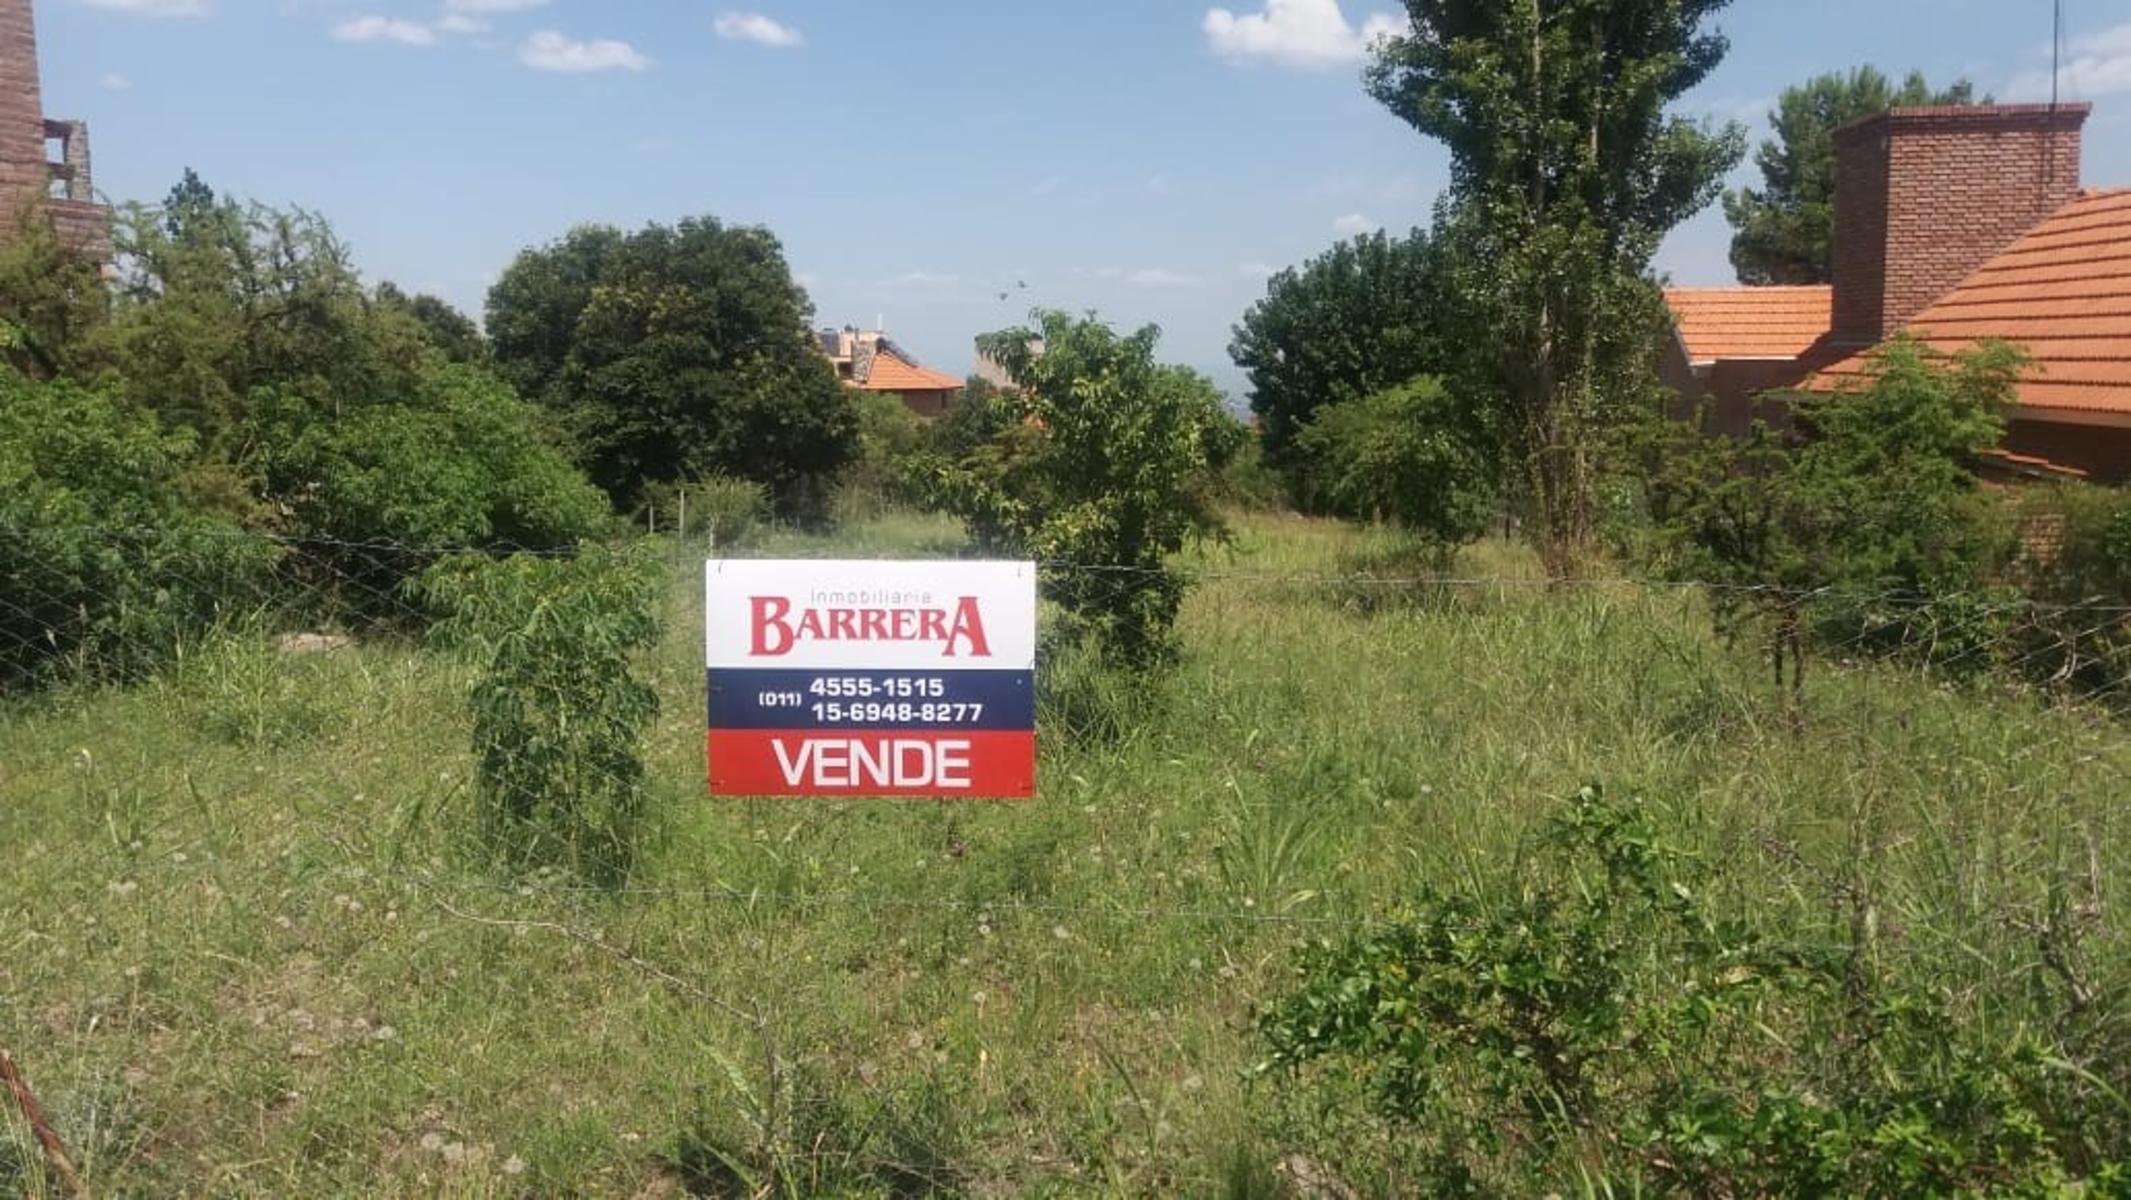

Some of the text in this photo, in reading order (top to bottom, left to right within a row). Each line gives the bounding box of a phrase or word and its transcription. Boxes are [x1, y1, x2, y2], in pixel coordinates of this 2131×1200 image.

[748, 596, 992, 656] BARRERA
[809, 678, 944, 697] 4555-1515
[758, 691, 802, 707] (011)
[811, 703, 984, 722] 15-6948-8277
[771, 739, 971, 787] VENDE
